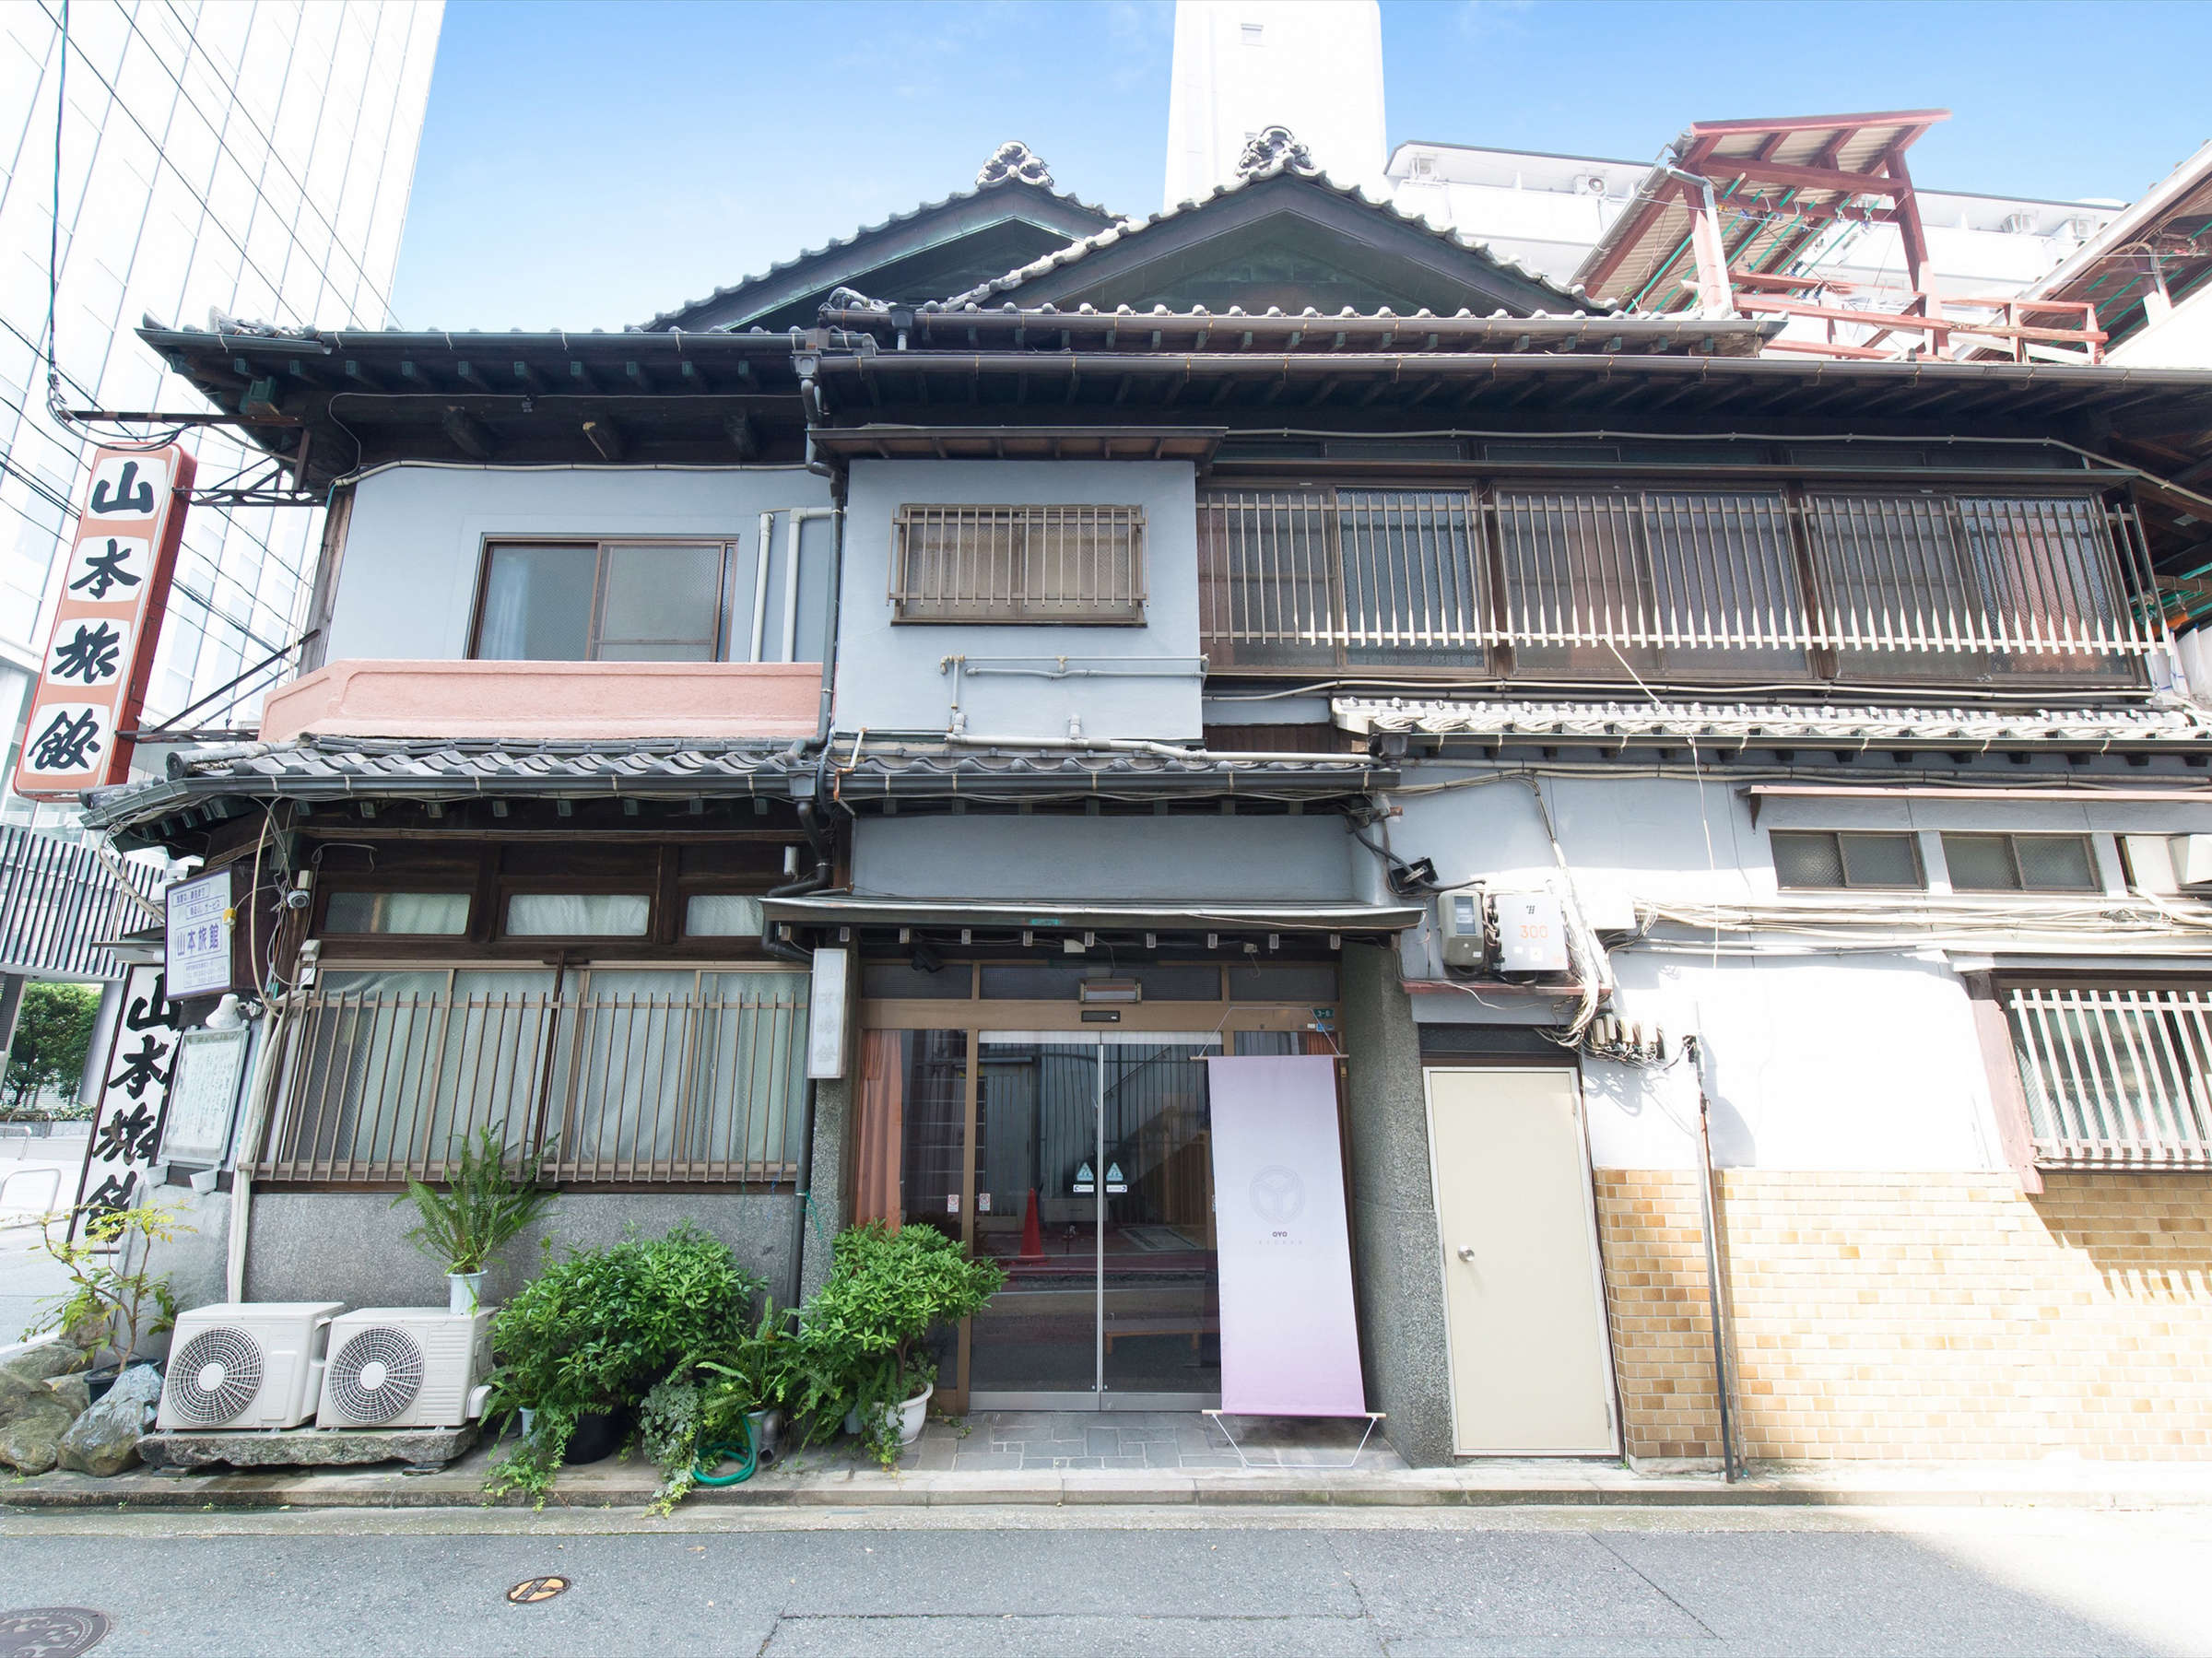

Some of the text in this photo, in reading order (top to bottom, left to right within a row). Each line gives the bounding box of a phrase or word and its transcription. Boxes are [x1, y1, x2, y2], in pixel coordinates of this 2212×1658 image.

[177, 923, 219, 957] 山本旅館
[1519, 924, 1549, 939] 300
